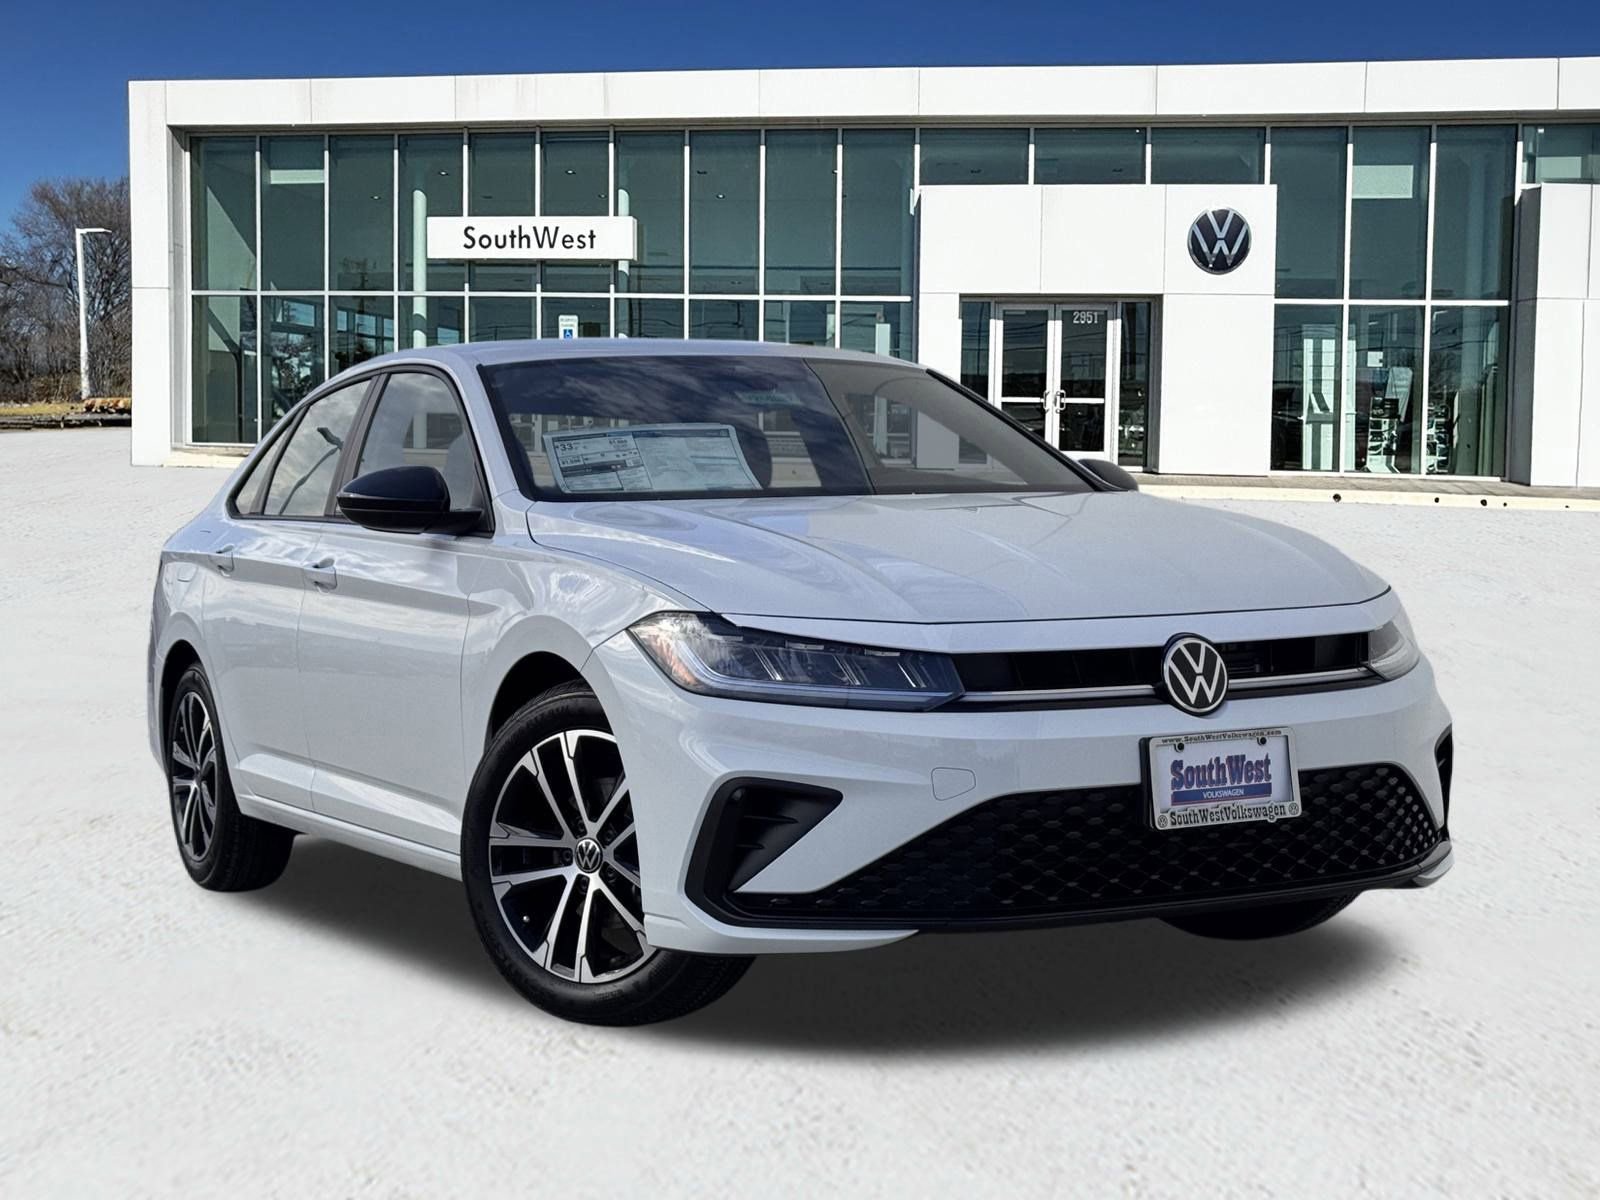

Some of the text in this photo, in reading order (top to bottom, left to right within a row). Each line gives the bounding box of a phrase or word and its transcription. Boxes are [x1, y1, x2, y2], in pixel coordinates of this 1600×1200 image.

[463, 225, 597, 249] SouthWest
[1187, 207, 1252, 275] VW
[1073, 311, 1098, 324] 2951
[1164, 637, 1228, 712] VW
[1170, 752, 1272, 791] SouthWest
[1202, 788, 1245, 800] VOLKSWAGEN
[1170, 803, 1286, 826] SouthWestVolkswagen
[576, 839, 601, 872] VW
